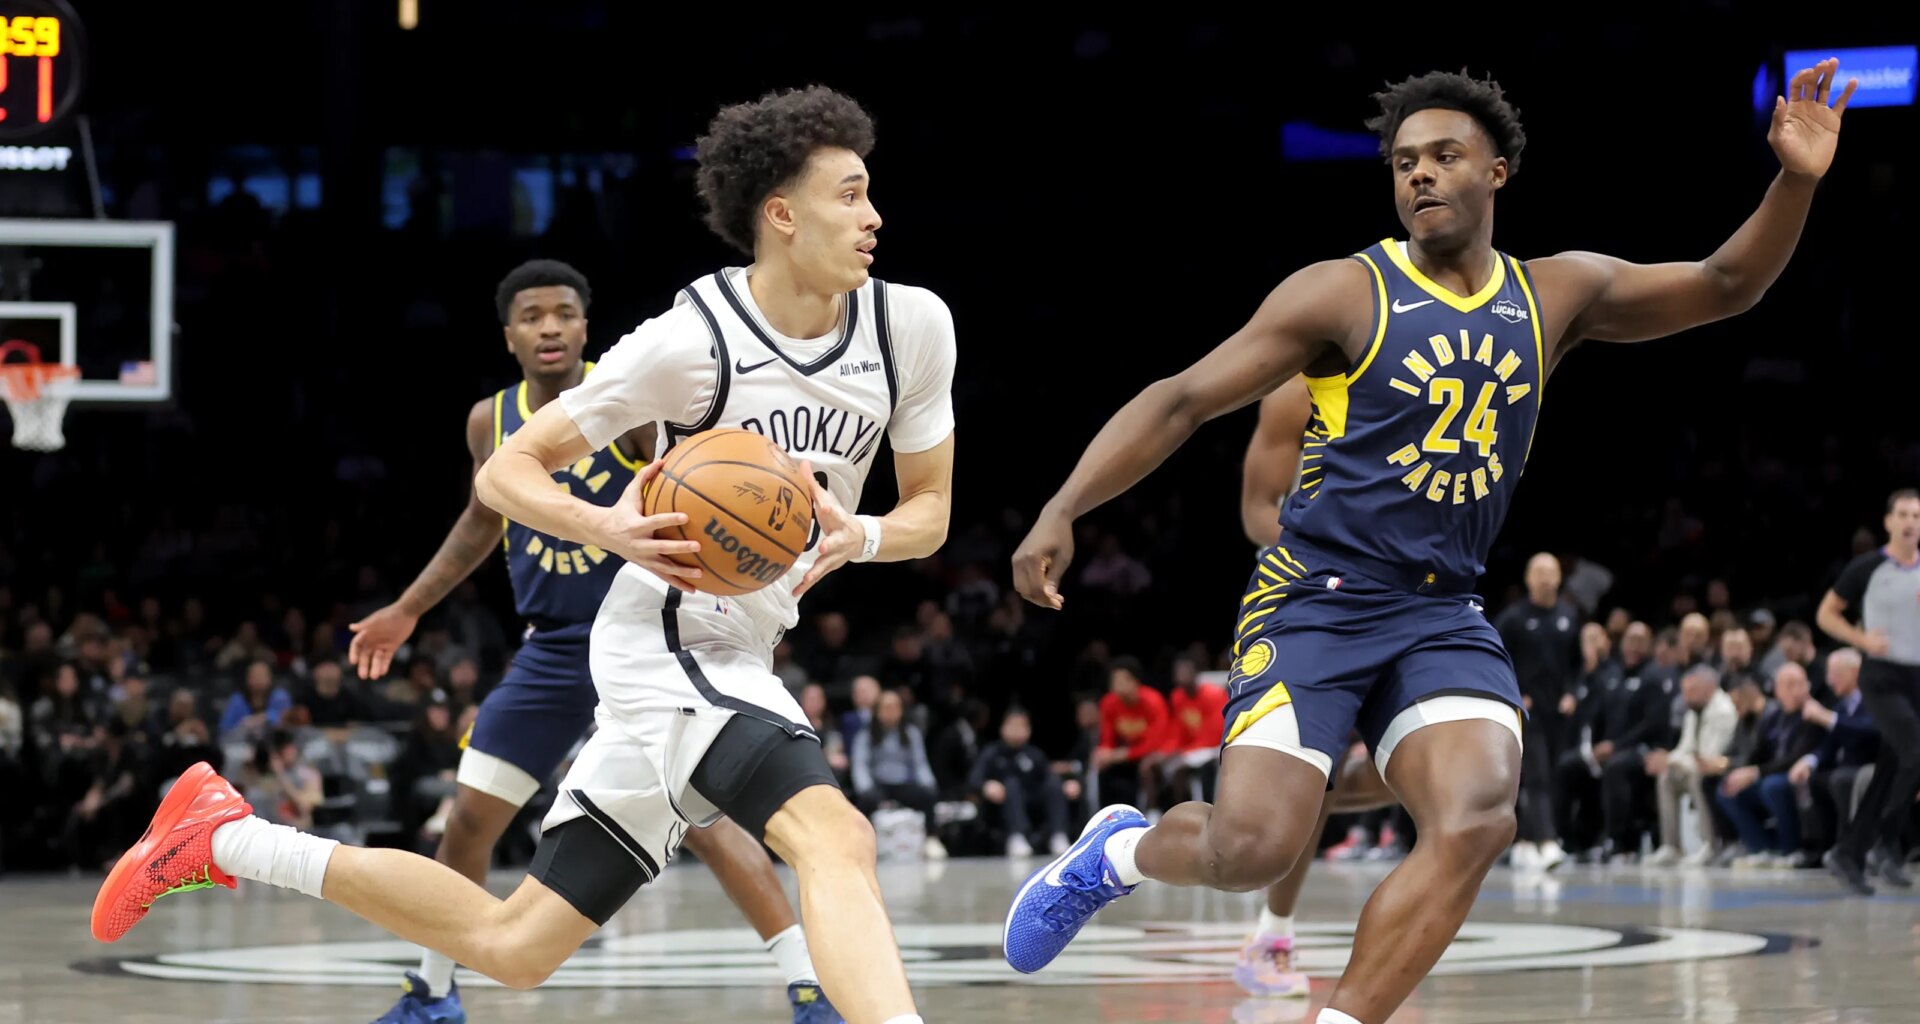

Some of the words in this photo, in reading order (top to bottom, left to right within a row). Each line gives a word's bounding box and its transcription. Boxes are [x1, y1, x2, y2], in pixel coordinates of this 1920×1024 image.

[0, 56, 53, 123] 1
[1491, 304, 1516, 317] LUCAS
[1516, 309, 1529, 320] OIL
[840, 363, 851, 377] All
[850, 362, 861, 375] In
[859, 360, 881, 373] Won
[1388, 329, 1531, 406] INDIANA
[741, 405, 882, 466] OOKLYN
[1422, 377, 1498, 457] 24
[1386, 443, 1504, 505] PACERS
[703, 516, 787, 585] Wilson
